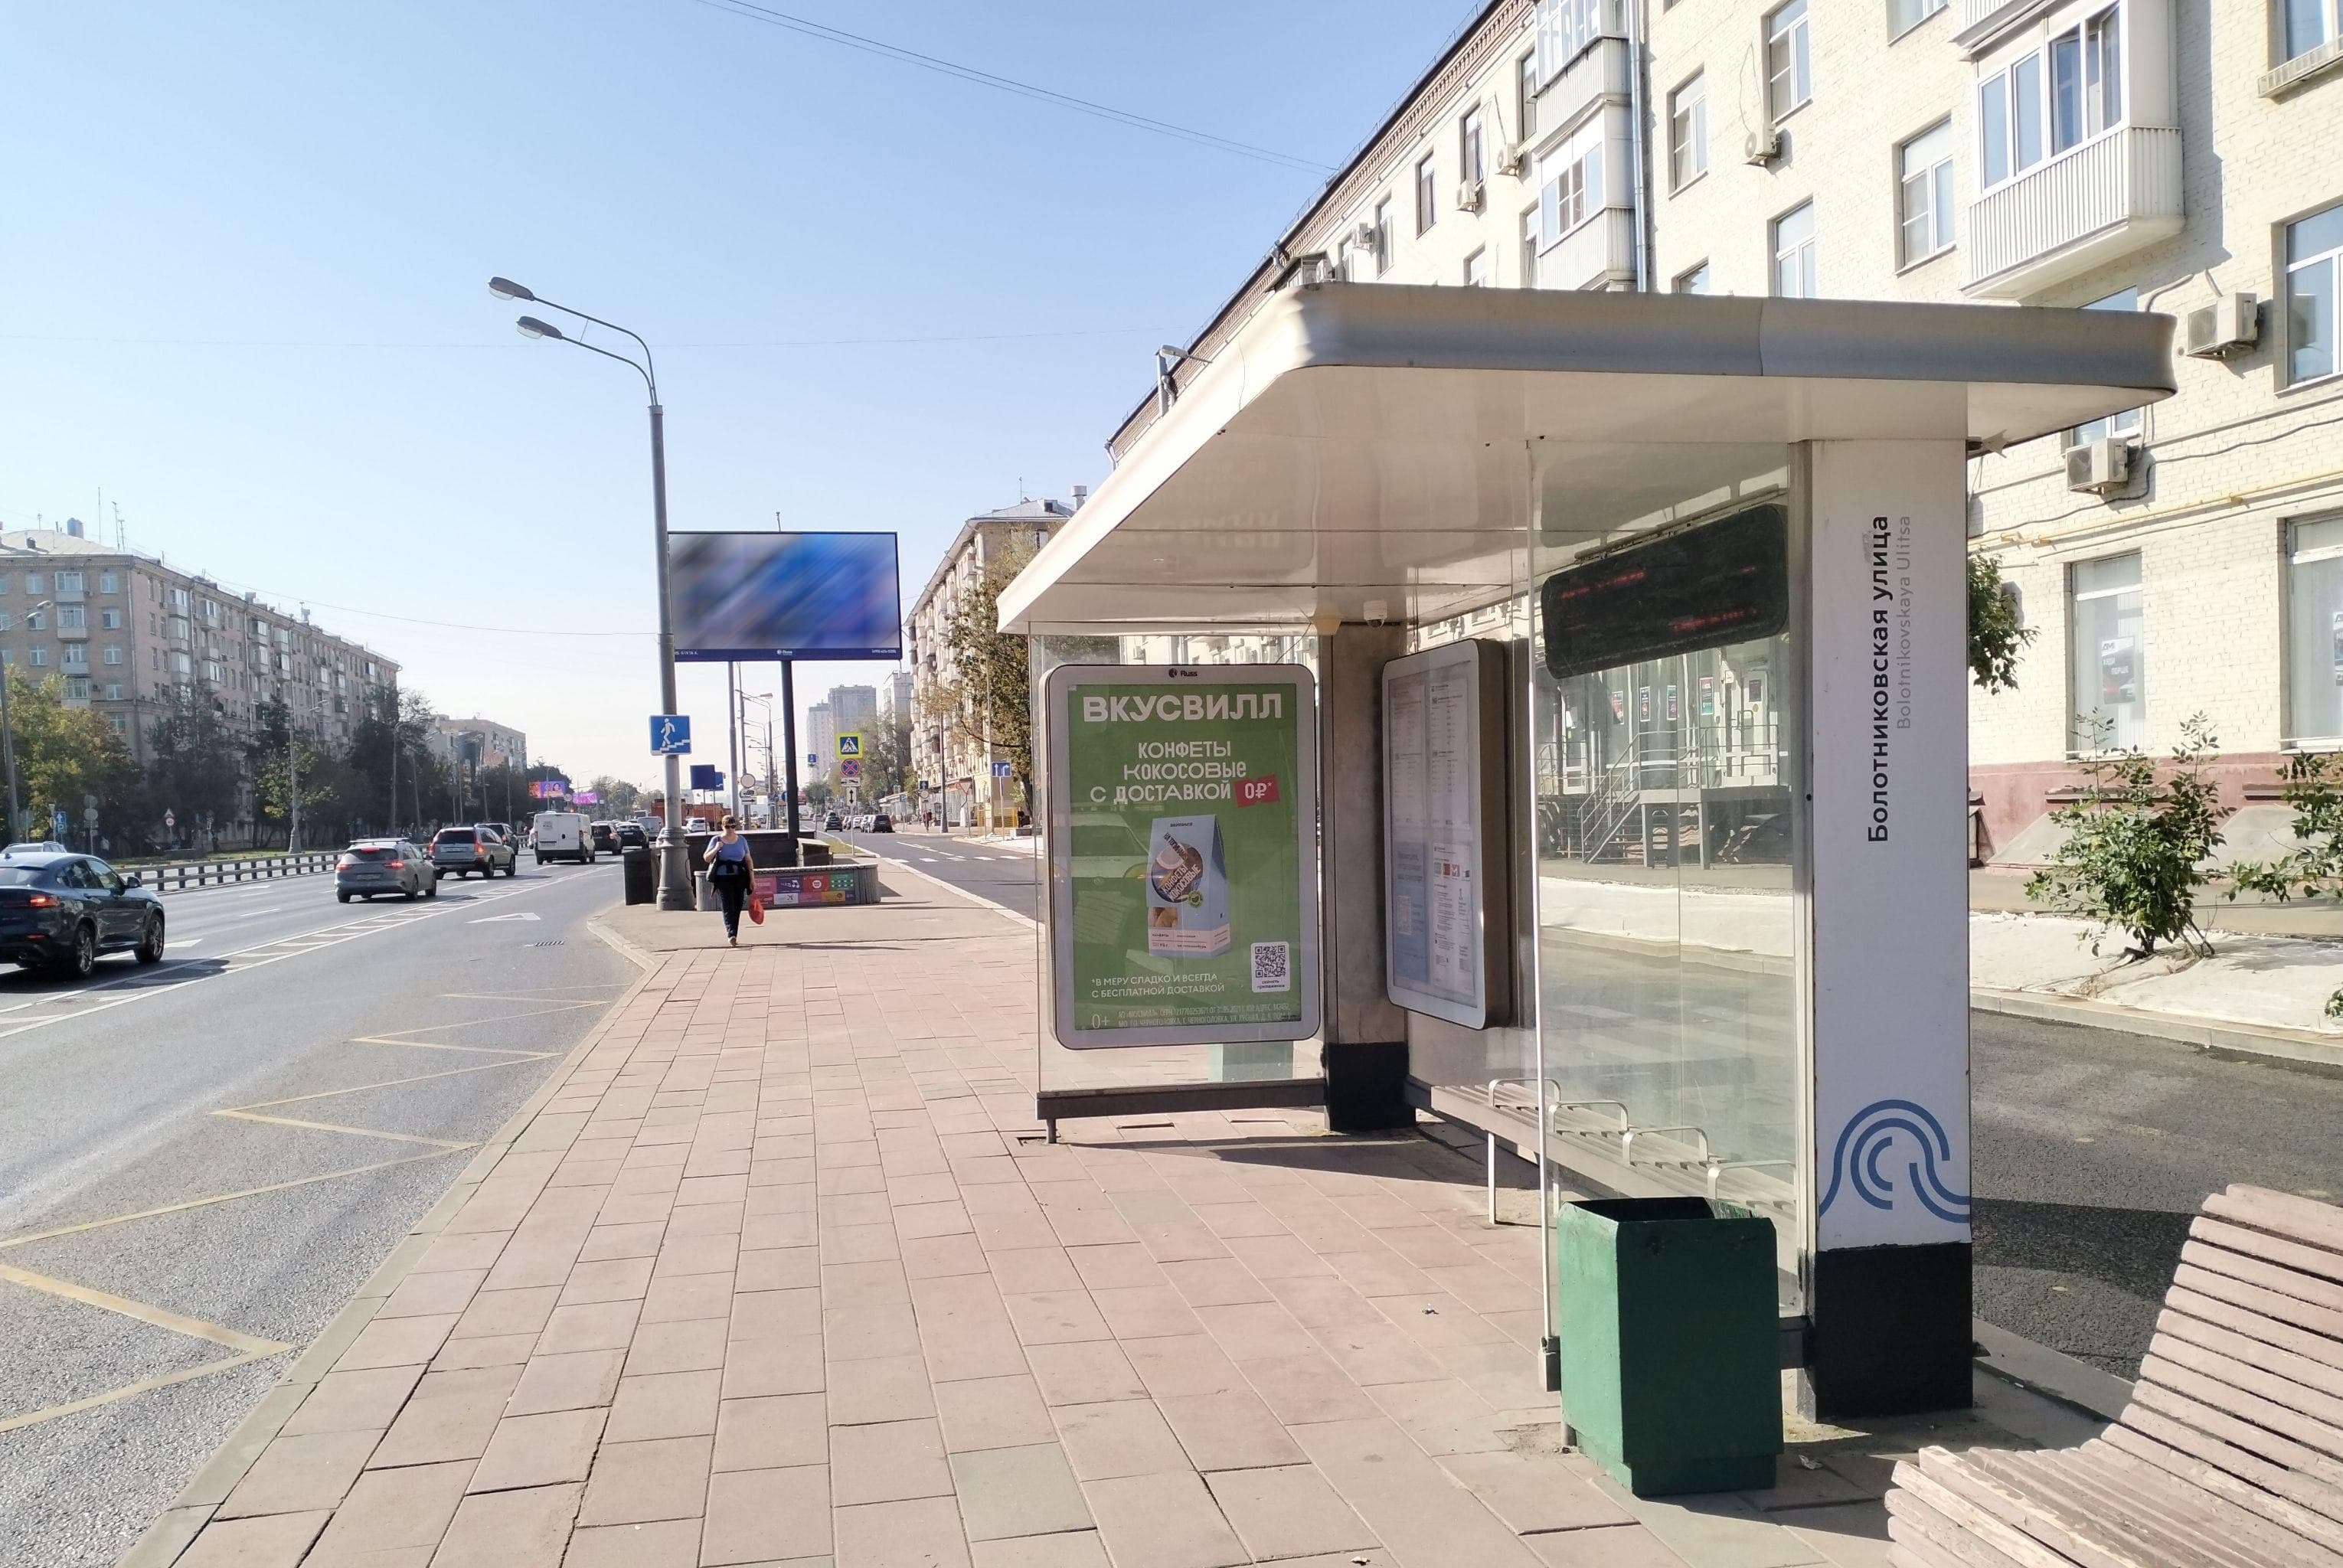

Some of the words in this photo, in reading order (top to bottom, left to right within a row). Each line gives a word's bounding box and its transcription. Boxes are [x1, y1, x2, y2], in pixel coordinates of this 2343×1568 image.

[1897, 515, 1910, 570] Ulitsa
[1873, 515, 1893, 600] улица
[1897, 577, 1913, 729] Bolotnikovskaya
[1083, 693, 1282, 722] ВКУСВИЛЛ
[1868, 609, 1888, 842] Болотниковская
[1138, 740, 1231, 760] КОНФЕТЫ
[1090, 786, 1106, 803] С
[1113, 779, 1231, 805] ДОСТАВКОЙ
[1161, 864, 1188, 893] КОНФЕТЫ
[1168, 864, 1201, 902] КОКОСОВЫЕ
[1091, 990, 1099, 998] С
[1101, 986, 1165, 998] БЕСПЛАТНОЙ
[1167, 983, 1225, 995] ДОСТАВКОЙ
[1103, 977, 1129, 985] МЕРУ
[1130, 975, 1171, 985] СЛАДКО
[1182, 973, 1217, 982] ВСЕГДА
[1092, 1014, 1110, 1029] 0+
